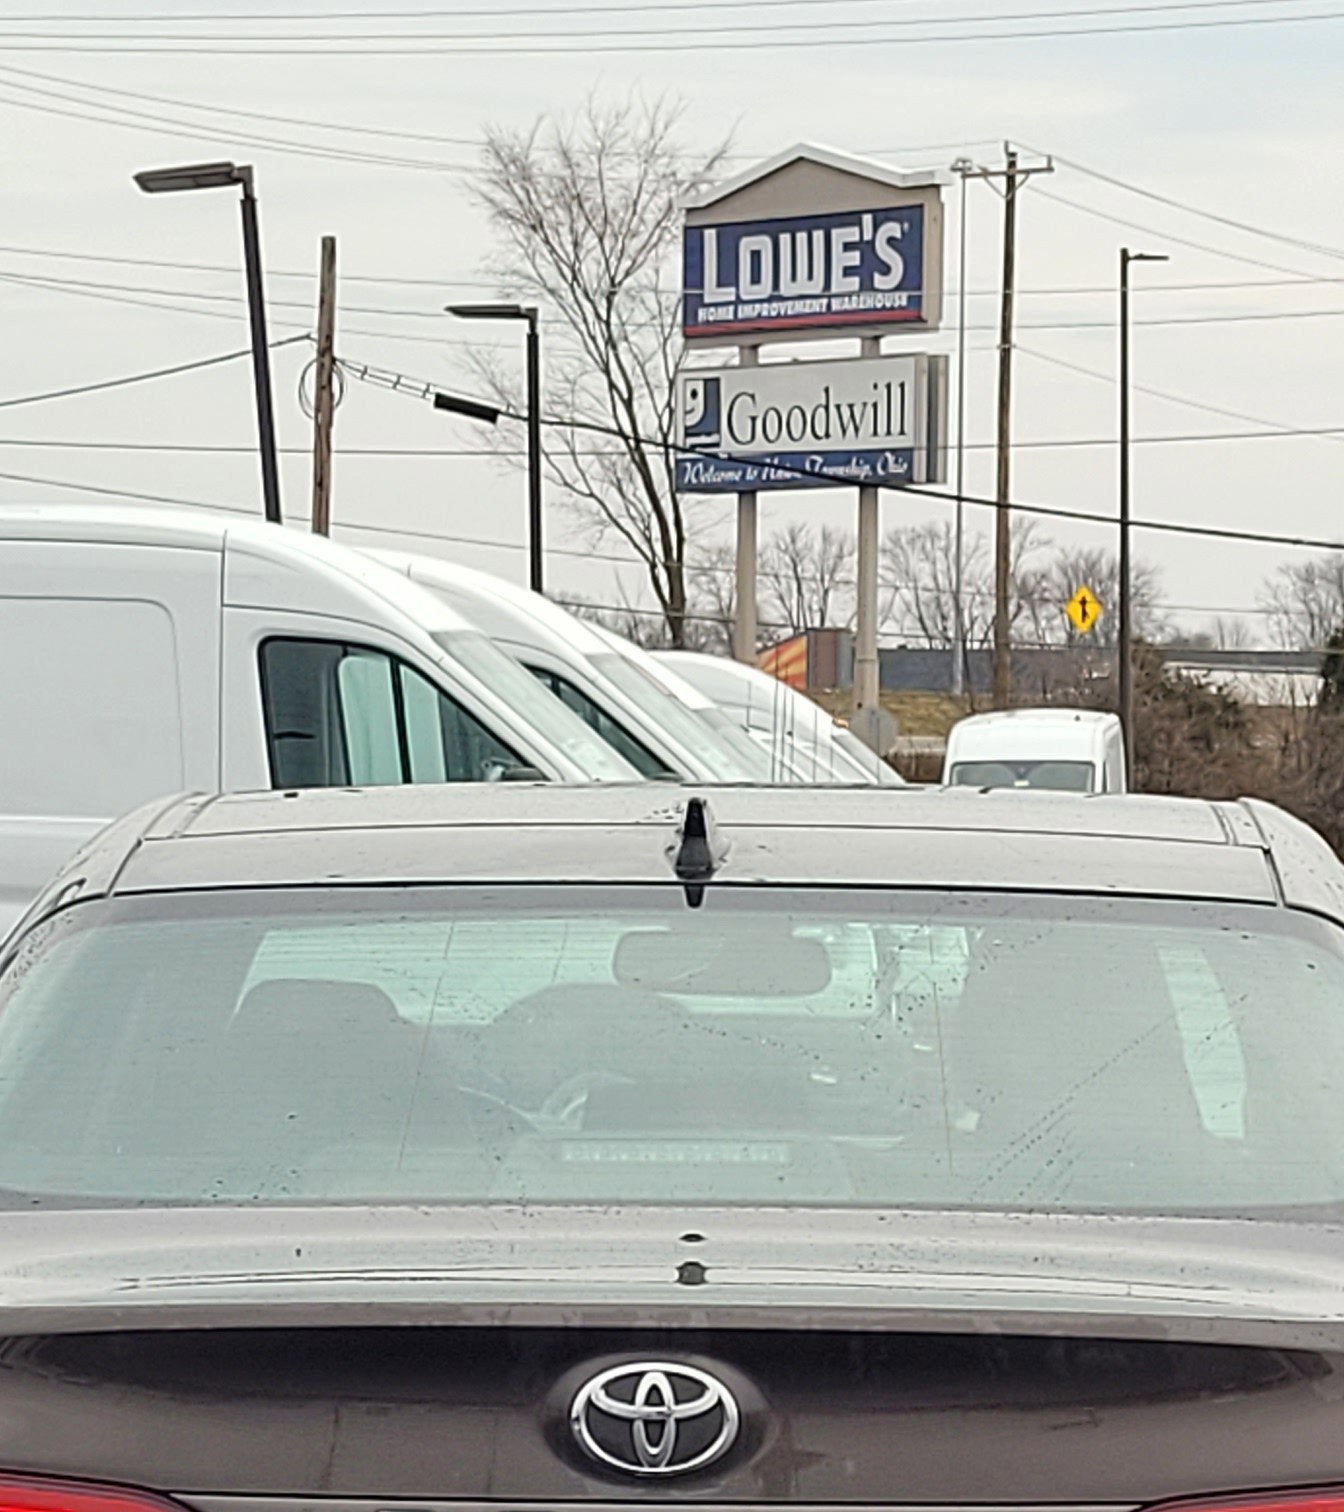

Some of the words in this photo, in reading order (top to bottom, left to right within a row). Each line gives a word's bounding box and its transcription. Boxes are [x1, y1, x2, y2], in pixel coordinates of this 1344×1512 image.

[703, 213, 905, 304] LOWE'S
[697, 304, 735, 323] HOME
[737, 297, 829, 319] IMPROVEMENT
[831, 293, 909, 312] WAREHOUSE
[727, 380, 907, 445] Goodwill
[683, 462, 743, 484] Welcome
[745, 466, 757, 481] to
[876, 451, 909, 475] Ohio
